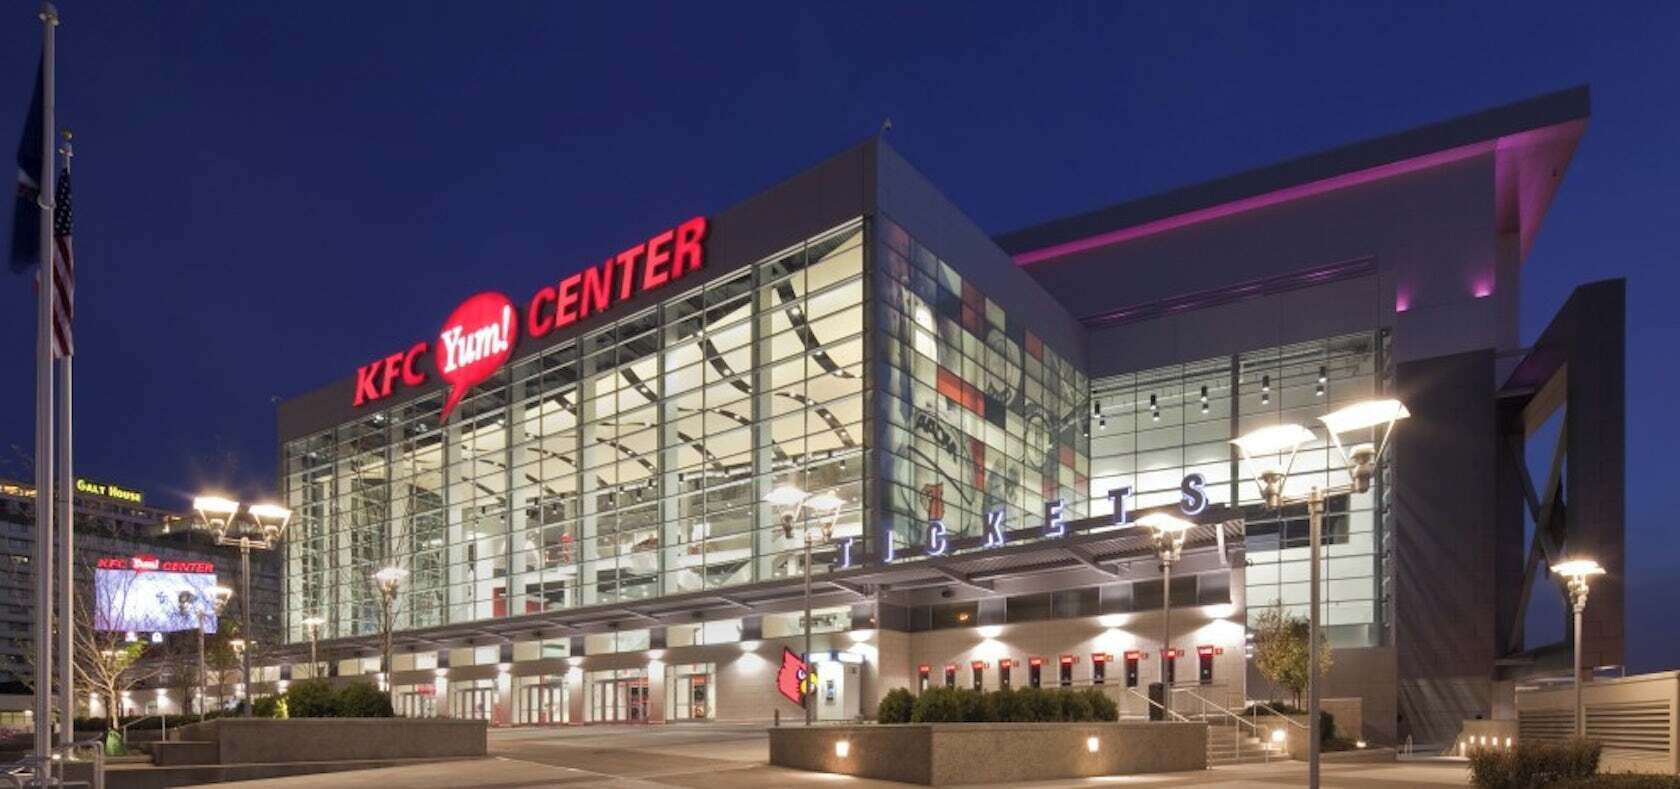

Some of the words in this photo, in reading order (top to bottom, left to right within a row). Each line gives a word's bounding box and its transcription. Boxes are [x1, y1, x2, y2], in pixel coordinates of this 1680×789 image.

[353, 341, 430, 407] KFC
[441, 304, 512, 374] Yum!
[528, 215, 709, 338] CENTER
[162, 561, 214, 573] CENTER
[840, 472, 1209, 568] TICKETS
